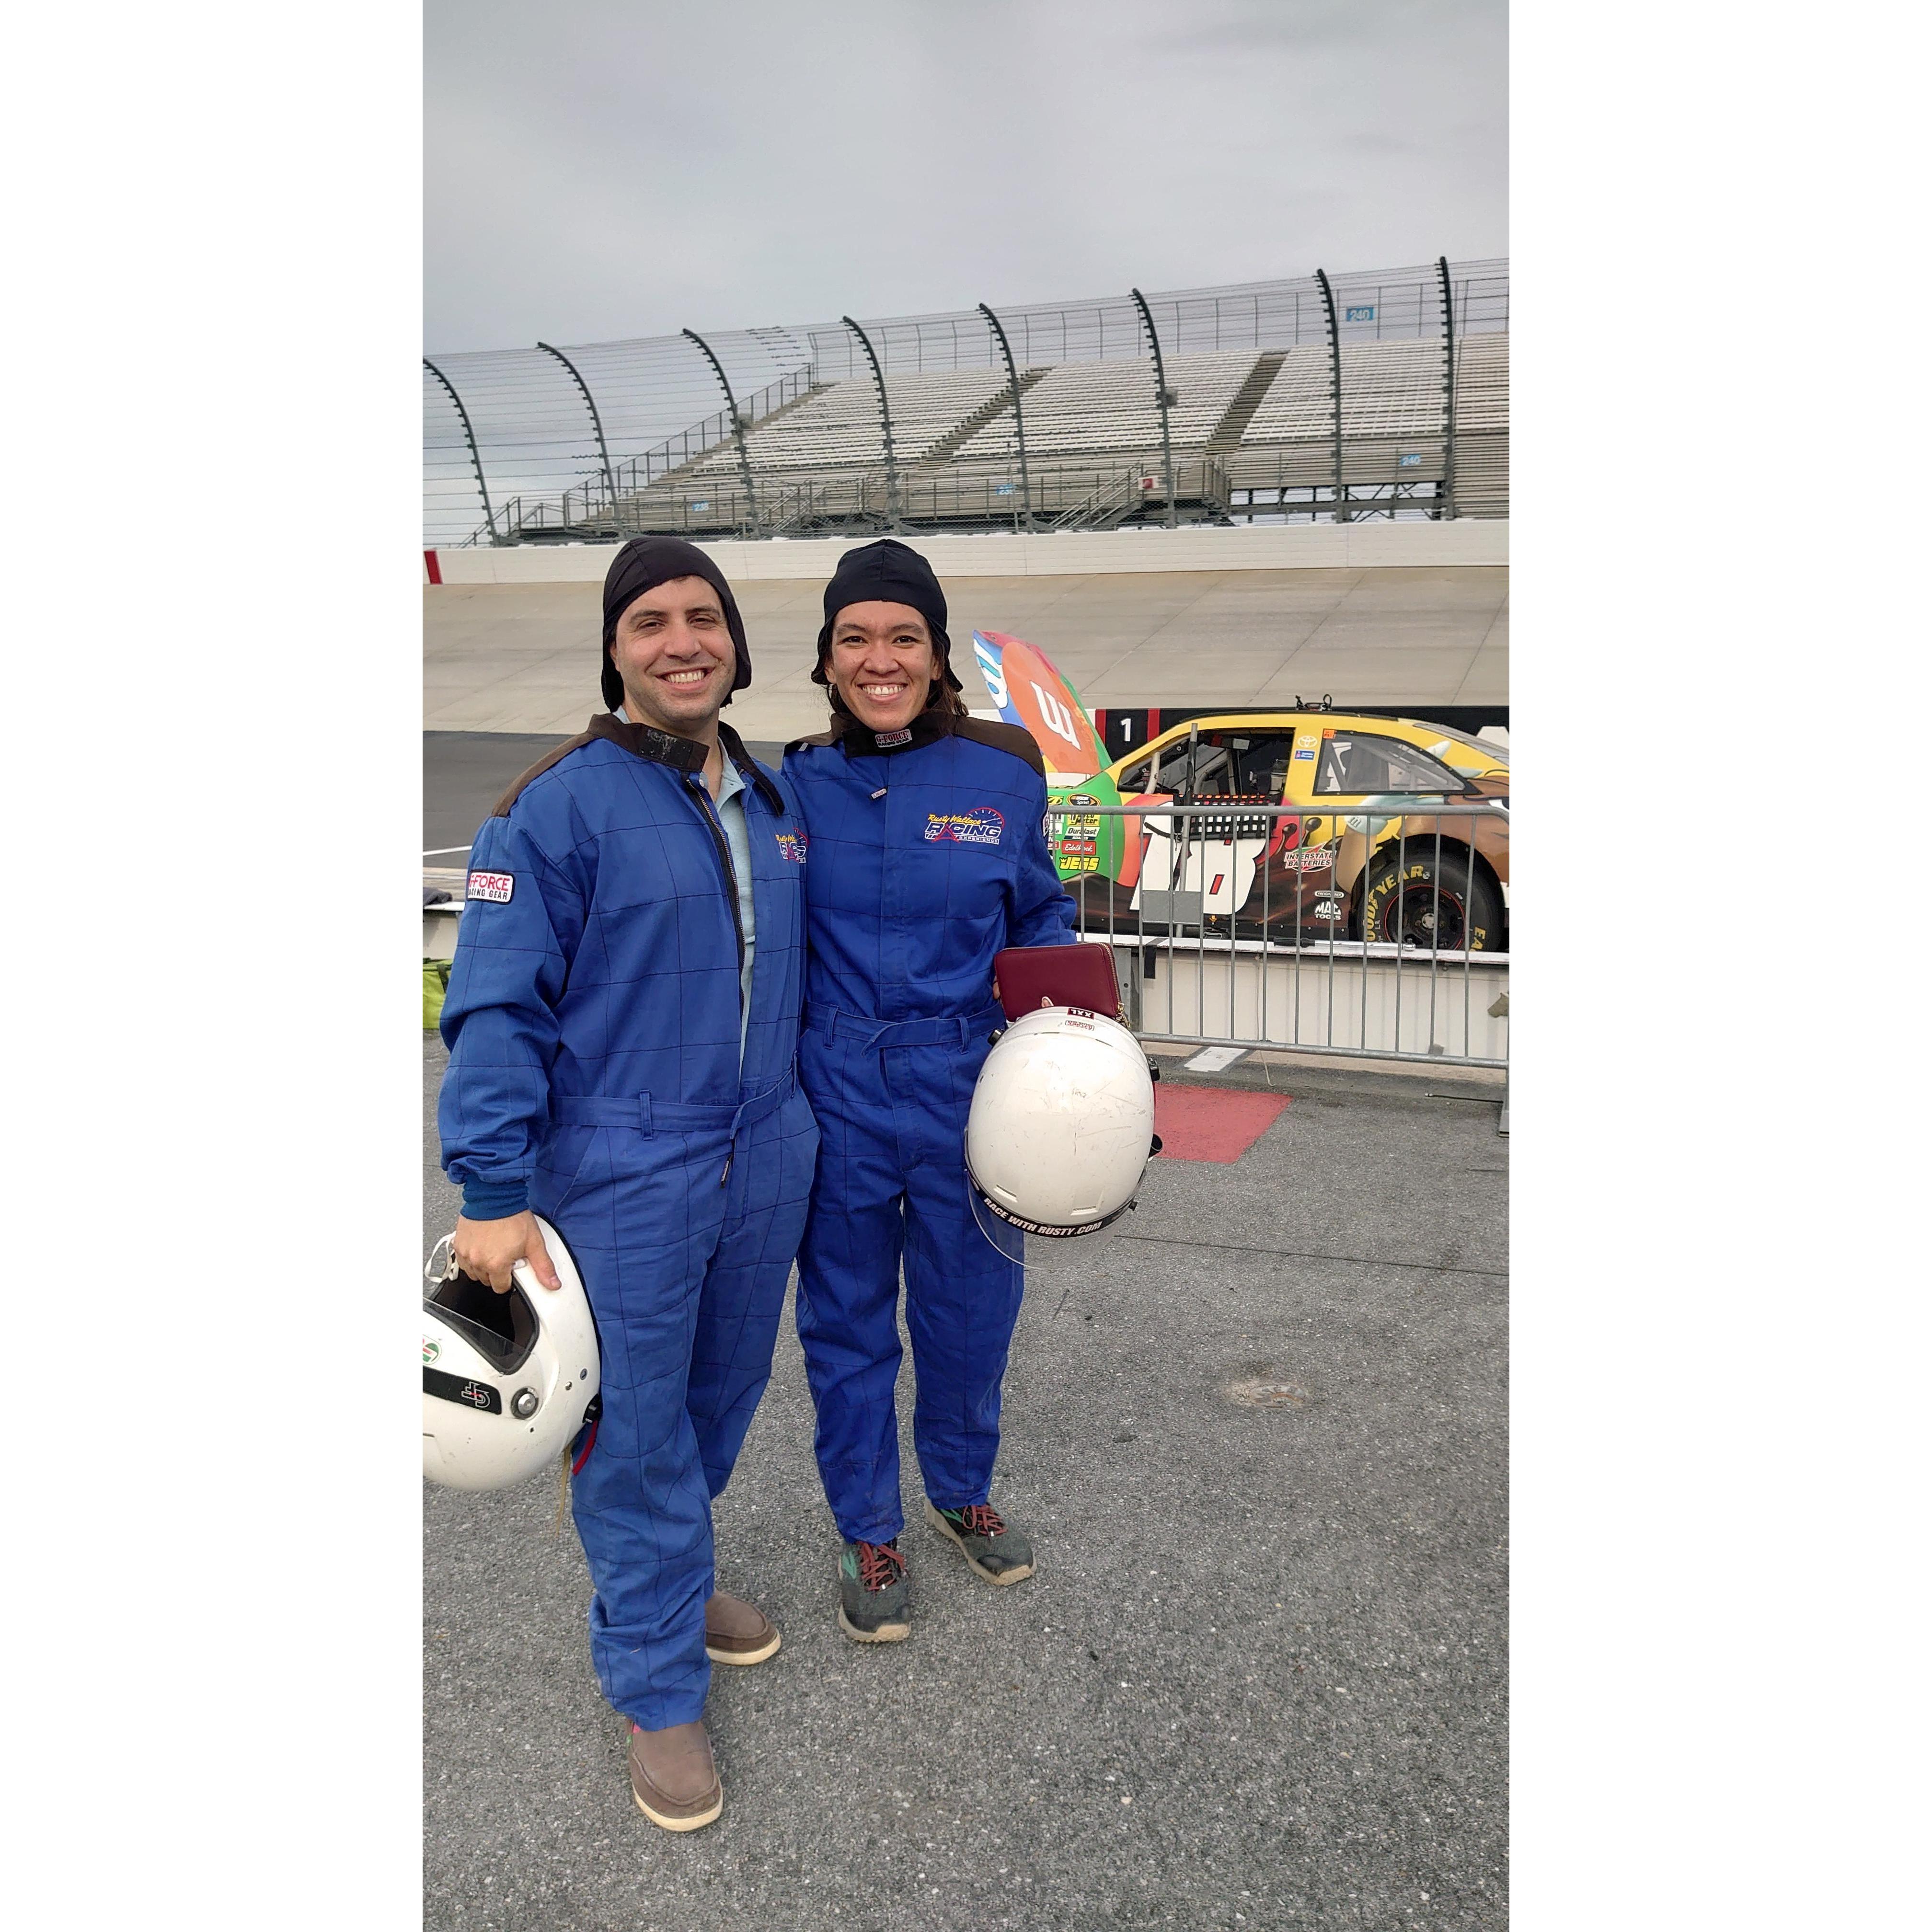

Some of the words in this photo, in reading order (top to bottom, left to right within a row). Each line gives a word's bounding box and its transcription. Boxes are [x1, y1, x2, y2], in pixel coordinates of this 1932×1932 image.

[1351, 309, 1370, 322] 240
[876, 730, 909, 743] G-FORCE
[1120, 718, 1131, 742] 1
[928, 814, 950, 824] Rusty
[950, 815, 982, 825] Wallace
[925, 821, 1002, 843] RACING
[959, 835, 999, 843] EXPERIENCE
[489, 890, 508, 900] GEAR
[1070, 1009, 1092, 1018] XXL
[984, 1197, 1009, 1219] RACE
[1008, 1215, 1036, 1231] WITH
